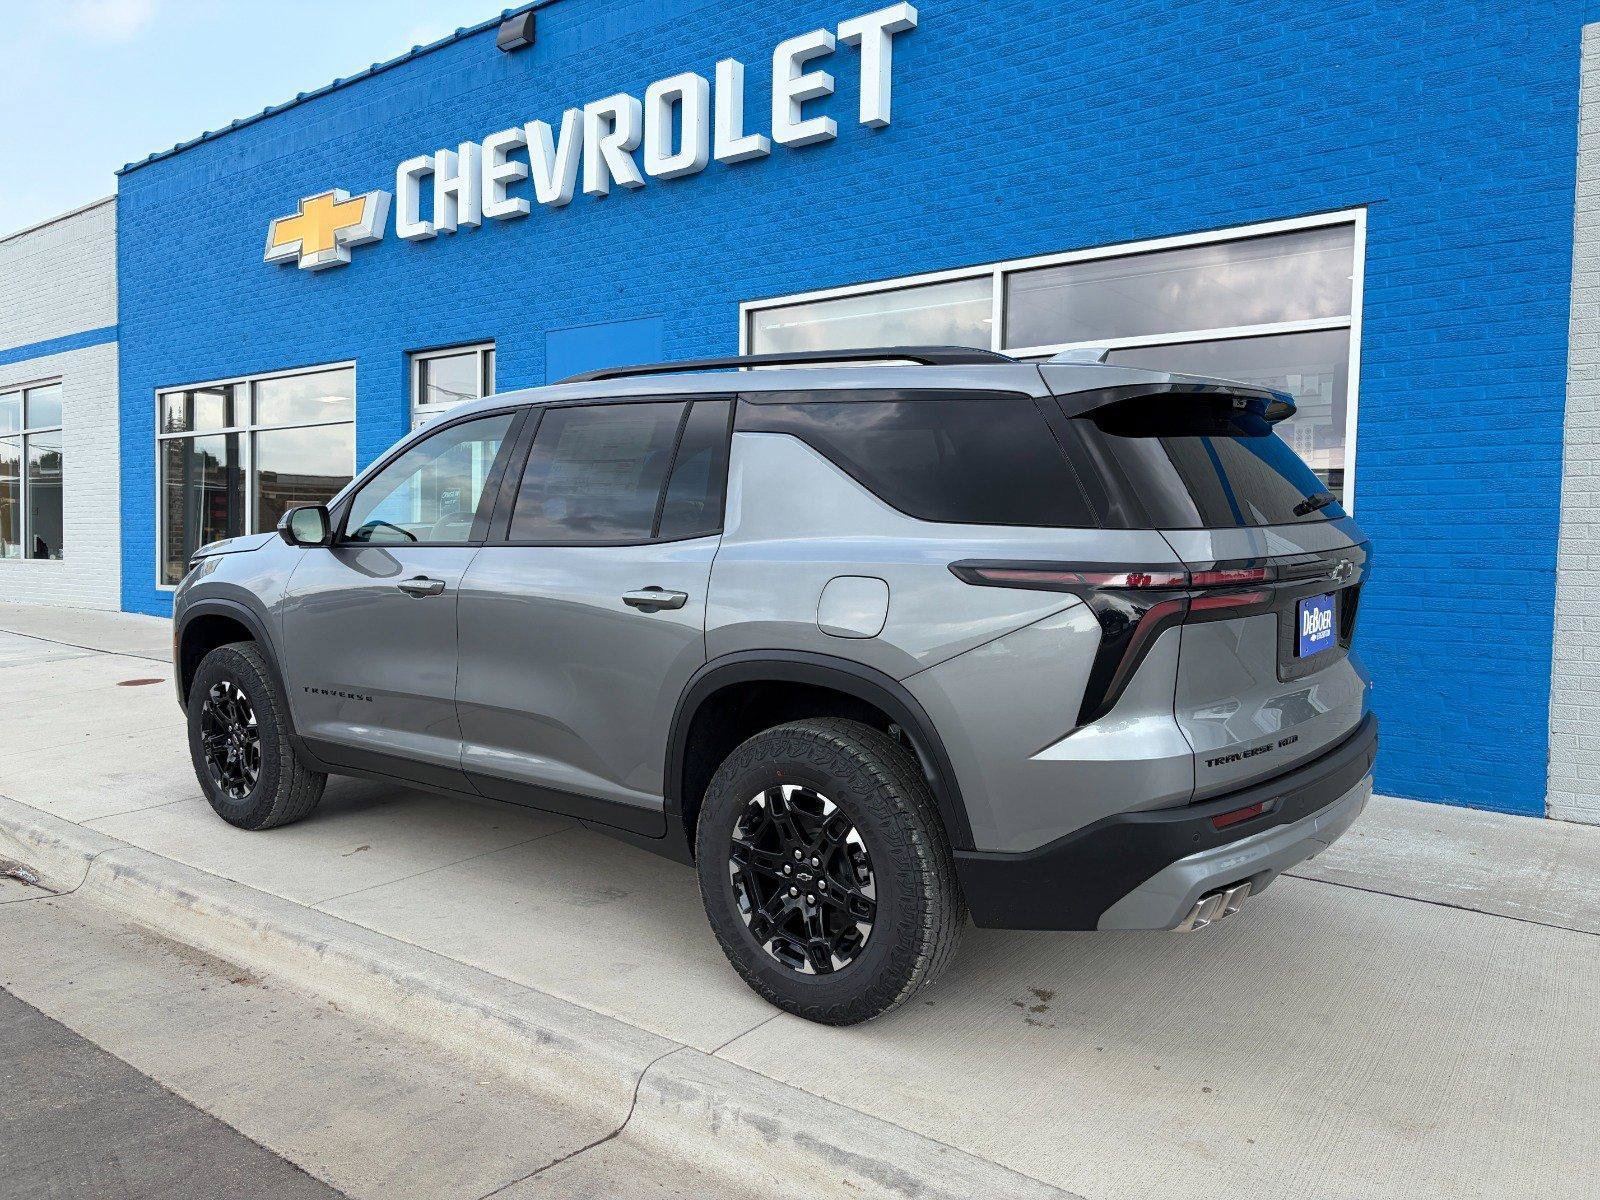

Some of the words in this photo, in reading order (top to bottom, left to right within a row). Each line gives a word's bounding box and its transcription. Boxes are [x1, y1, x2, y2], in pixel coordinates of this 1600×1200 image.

[395, 1, 918, 242] CHEVROLET
[302, 686, 374, 703] TRAVERSE
[1204, 742, 1274, 768] TRAVERSE
